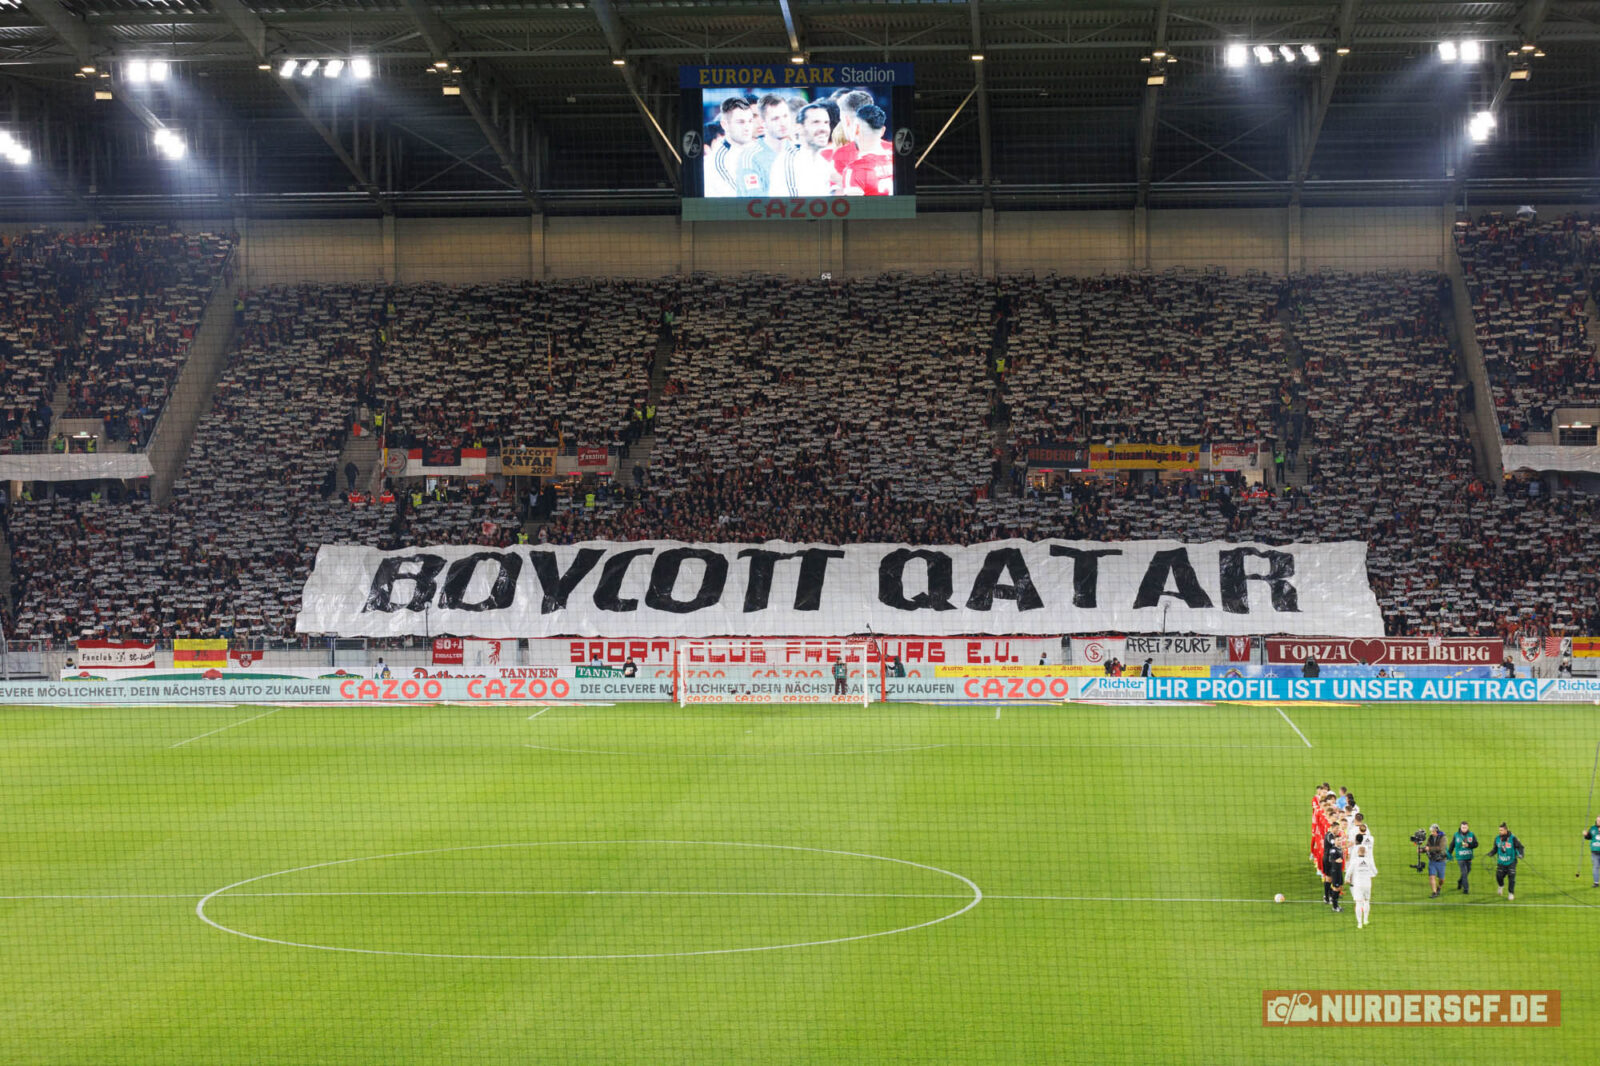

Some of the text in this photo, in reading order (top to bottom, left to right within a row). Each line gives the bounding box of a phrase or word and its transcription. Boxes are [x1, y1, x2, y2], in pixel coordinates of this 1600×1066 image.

[699, 66, 895, 85] EUROPA PARK Stadion
[746, 198, 850, 218] CAZOO
[502, 456, 553, 468] QATAR
[361, 544, 1303, 616] BOYCOTT QATAR
[82, 653, 112, 661] Fanclub
[570, 641, 670, 663] SPORT
[689, 641, 766, 663] CLUB
[1279, 644, 1491, 662] FORZA FREIBURG
[499, 668, 559, 678] TANNEN
[37, 684, 127, 699] MÖGLICHKEIT,
[131, 686, 160, 697] DEIN
[163, 683, 227, 697] NÄCHSTES
[230, 685, 263, 696] AUTO
[266, 685, 282, 695] ZU
[285, 685, 331, 695] KAUFEN
[339, 679, 443, 699] CAZOO
[467, 678, 570, 699] CAZOO
[580, 683, 601, 695] DIE
[604, 683, 656, 695] CLEVERE
[752, 683, 781, 693] DEIN
[888, 683, 904, 693] ZU
[907, 683, 955, 693] KAUFEN
[963, 678, 1069, 698] CAZOO
[1099, 678, 1145, 689] Richter
[1148, 679, 1535, 699] IHR PROFIL IST UNSER AUFTRAG
